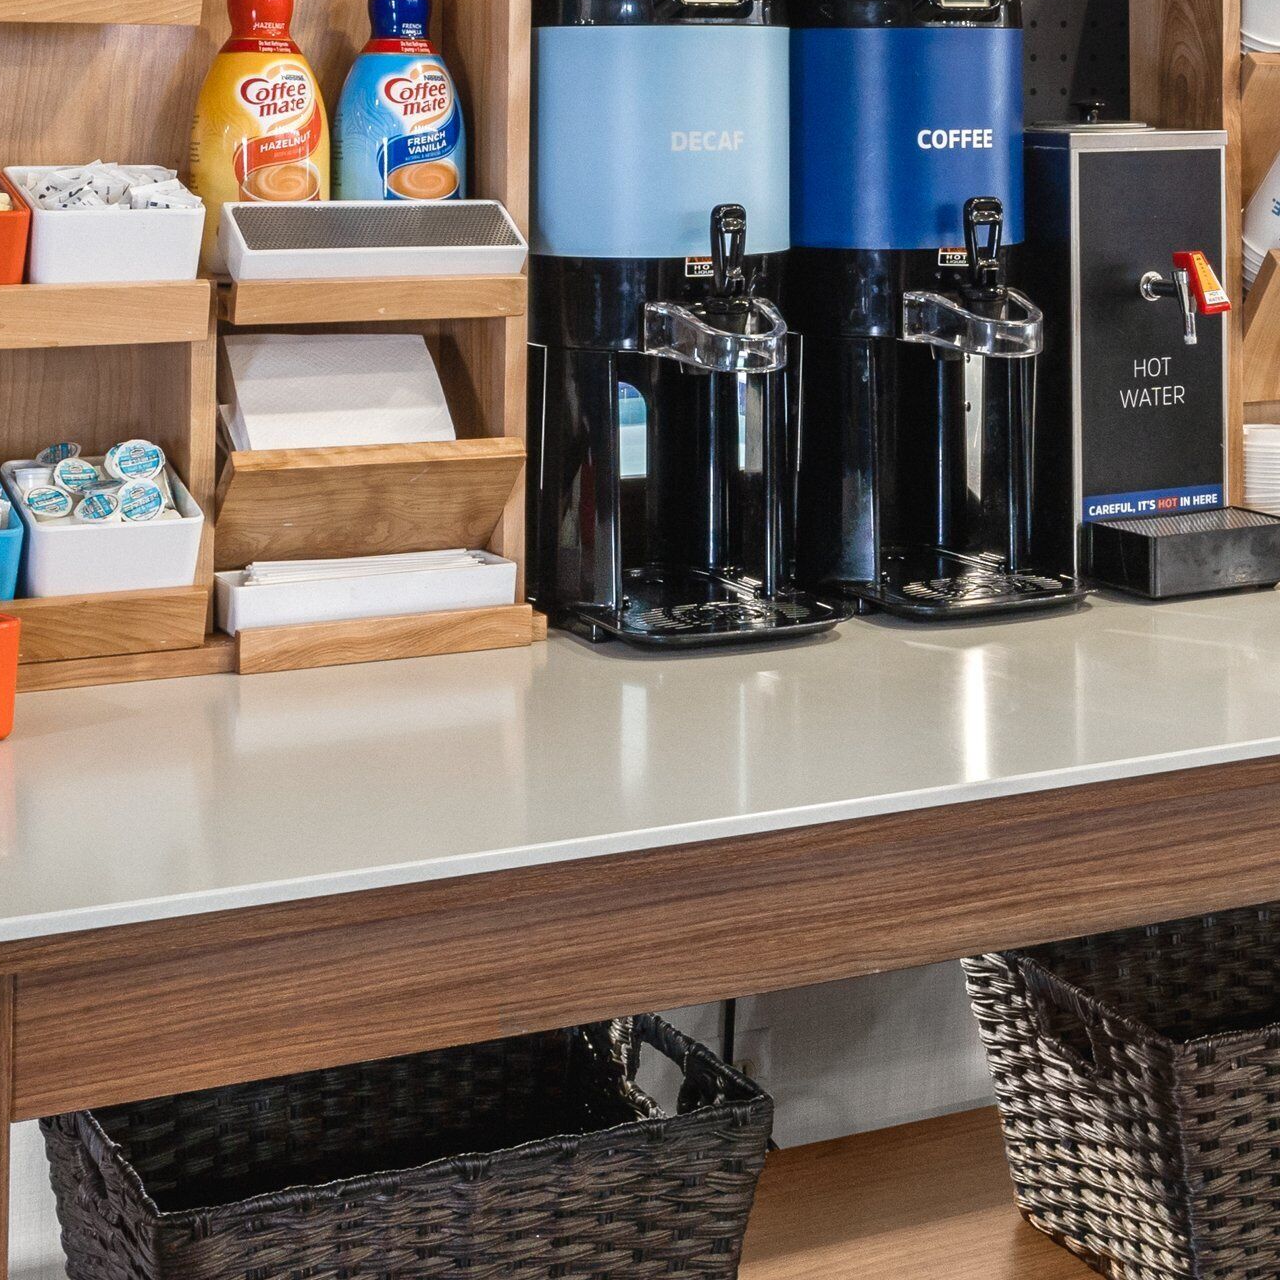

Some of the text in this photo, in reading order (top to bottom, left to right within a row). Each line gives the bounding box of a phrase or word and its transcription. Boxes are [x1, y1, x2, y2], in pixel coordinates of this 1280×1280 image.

[240, 78, 306, 105] Coffee
[384, 78, 446, 104] Coffee
[260, 97, 305, 117] mate
[402, 97, 445, 116] mate
[260, 130, 311, 153] HAZELNUT
[407, 130, 446, 146] FRENCH
[408, 139, 447, 155] VANILLA
[671, 131, 745, 151] DECAF
[917, 129, 993, 149] COFFEE
[1134, 357, 1171, 377] HOT
[1120, 385, 1185, 408] WATER
[1089, 494, 1217, 516] CAREFUL, IT'S HOT IN HERE
